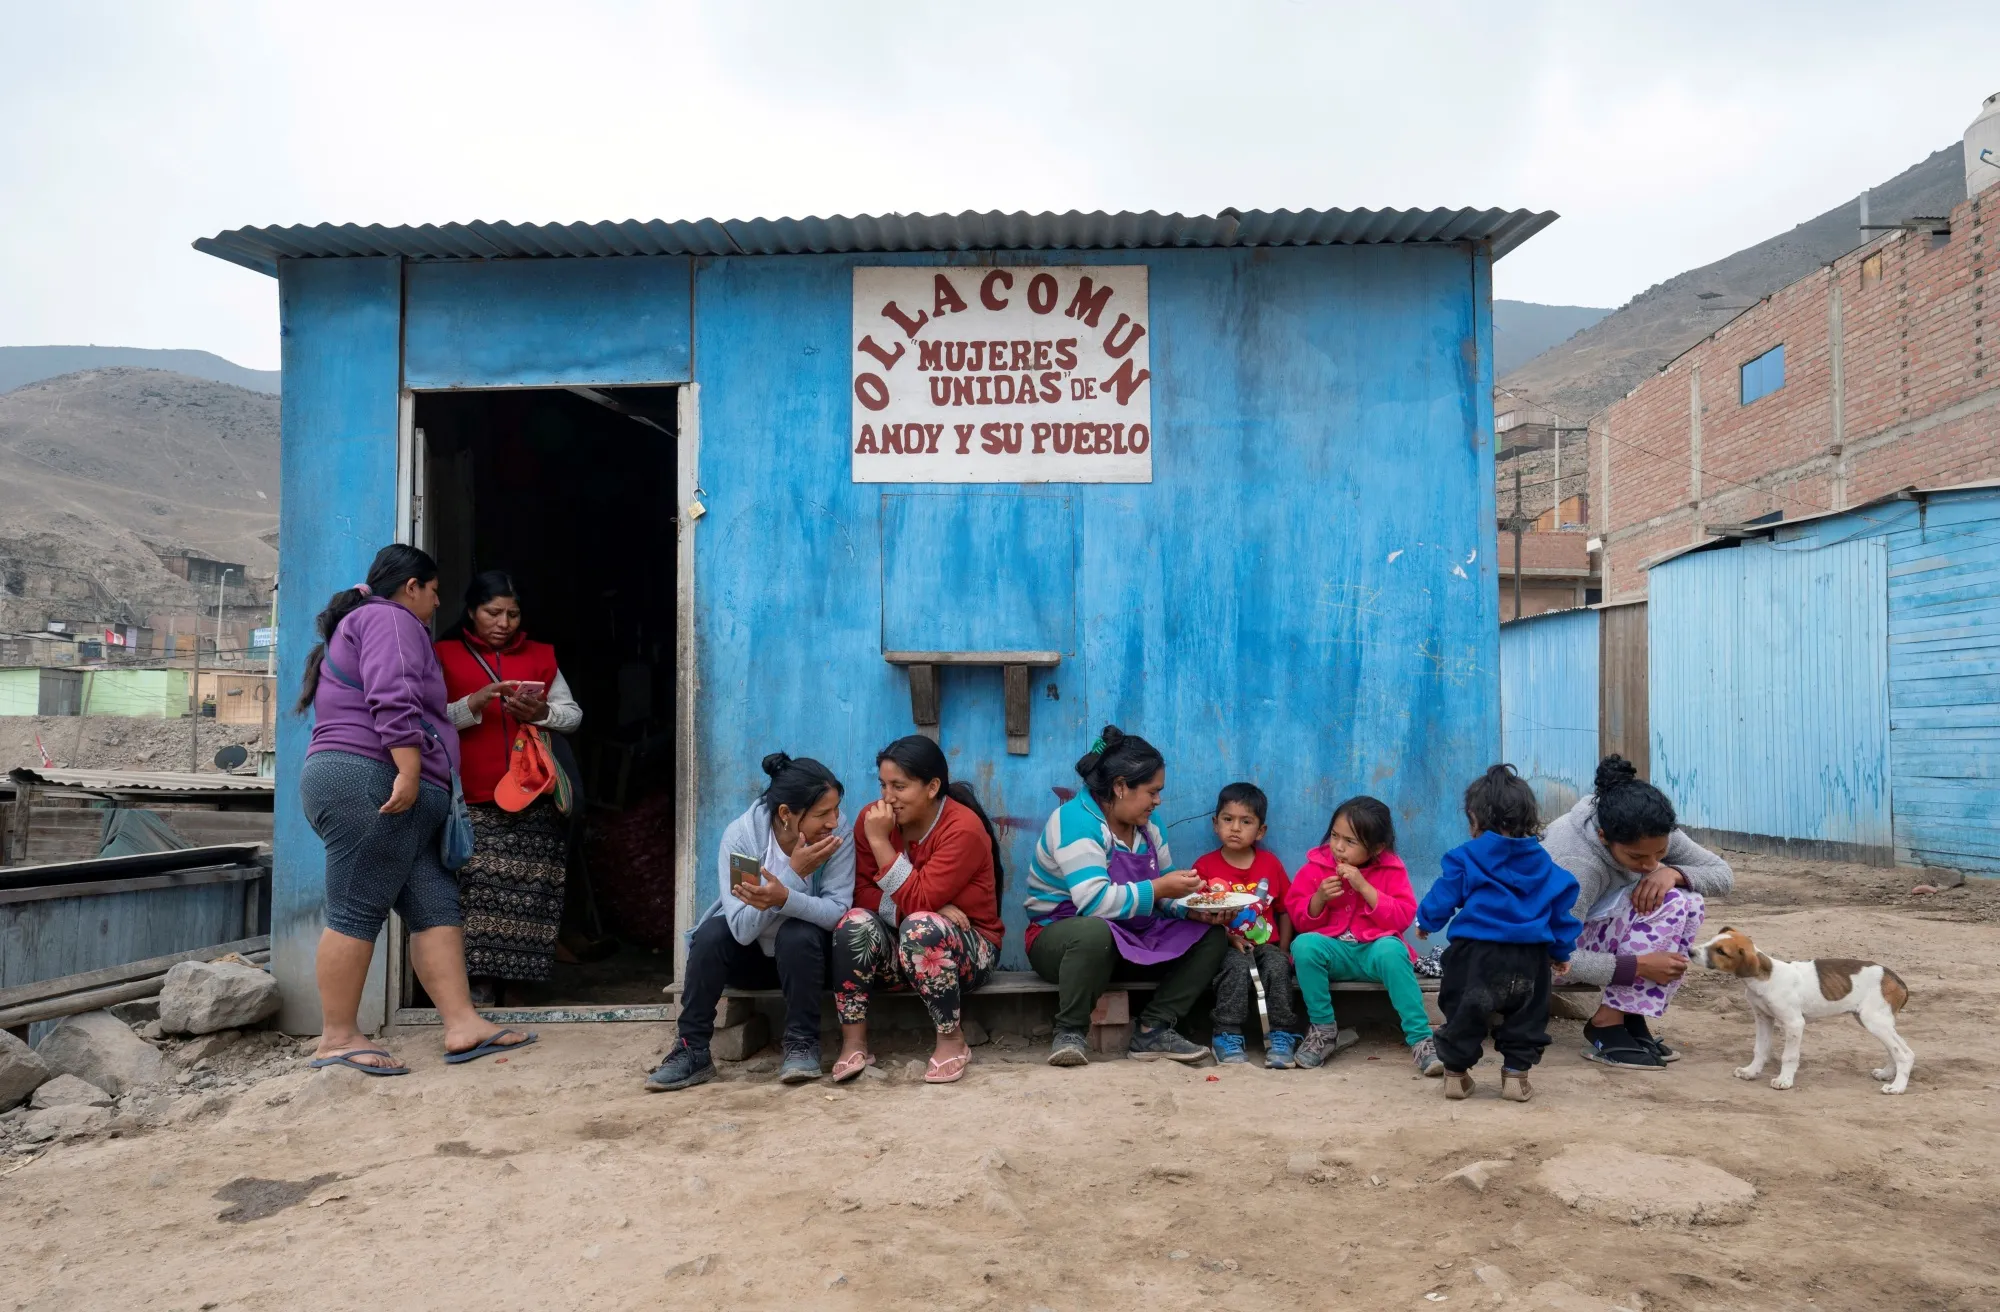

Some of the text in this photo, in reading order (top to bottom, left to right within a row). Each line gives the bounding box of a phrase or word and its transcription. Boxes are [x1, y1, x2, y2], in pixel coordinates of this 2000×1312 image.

[854, 269, 1151, 412] OLLA COMUN
[1071, 377, 1097, 401] DE
[855, 421, 1150, 455] ANDY Y SU PUEBLO
